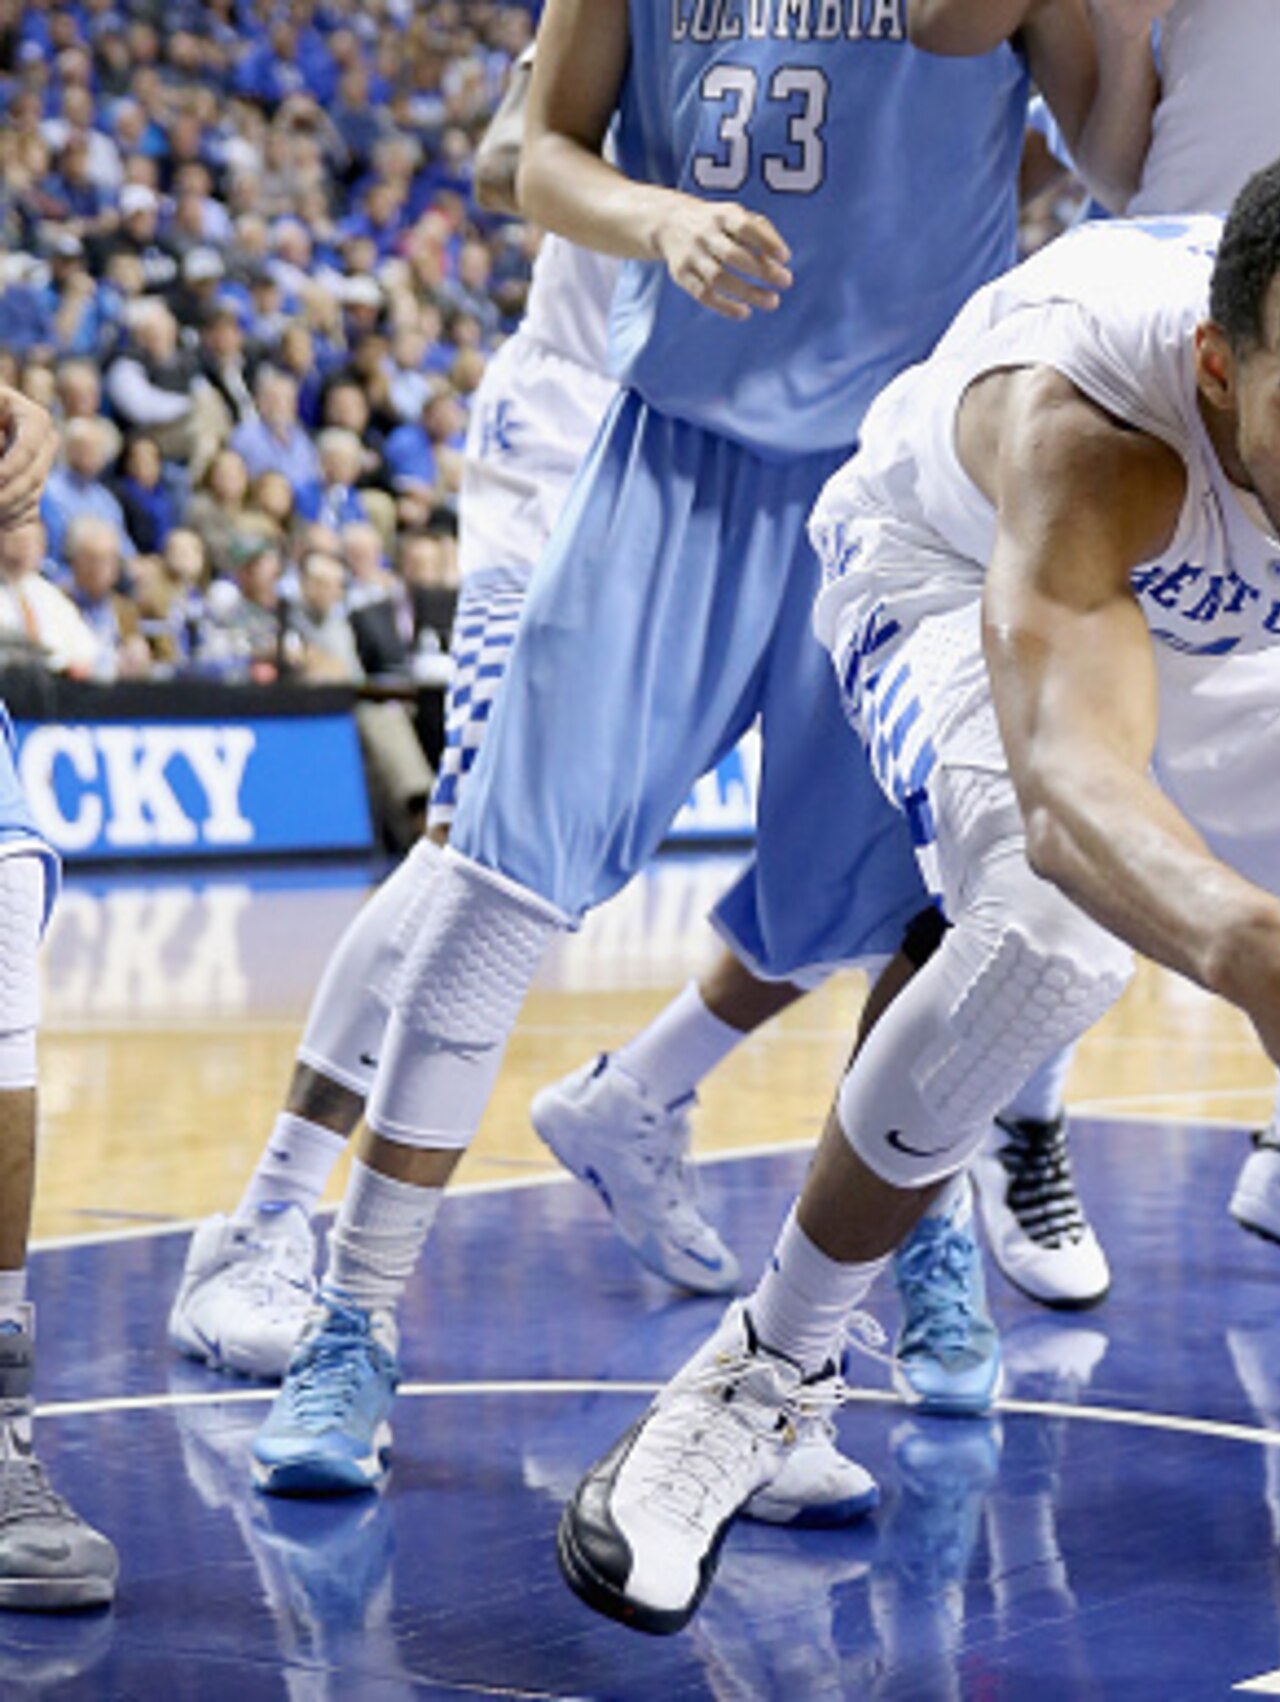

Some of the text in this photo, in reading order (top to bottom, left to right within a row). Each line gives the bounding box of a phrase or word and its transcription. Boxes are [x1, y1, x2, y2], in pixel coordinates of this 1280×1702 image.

[671, 0, 905, 43] COLUMBIA
[693, 64, 830, 193] 33
[18, 724, 256, 852] CKY
